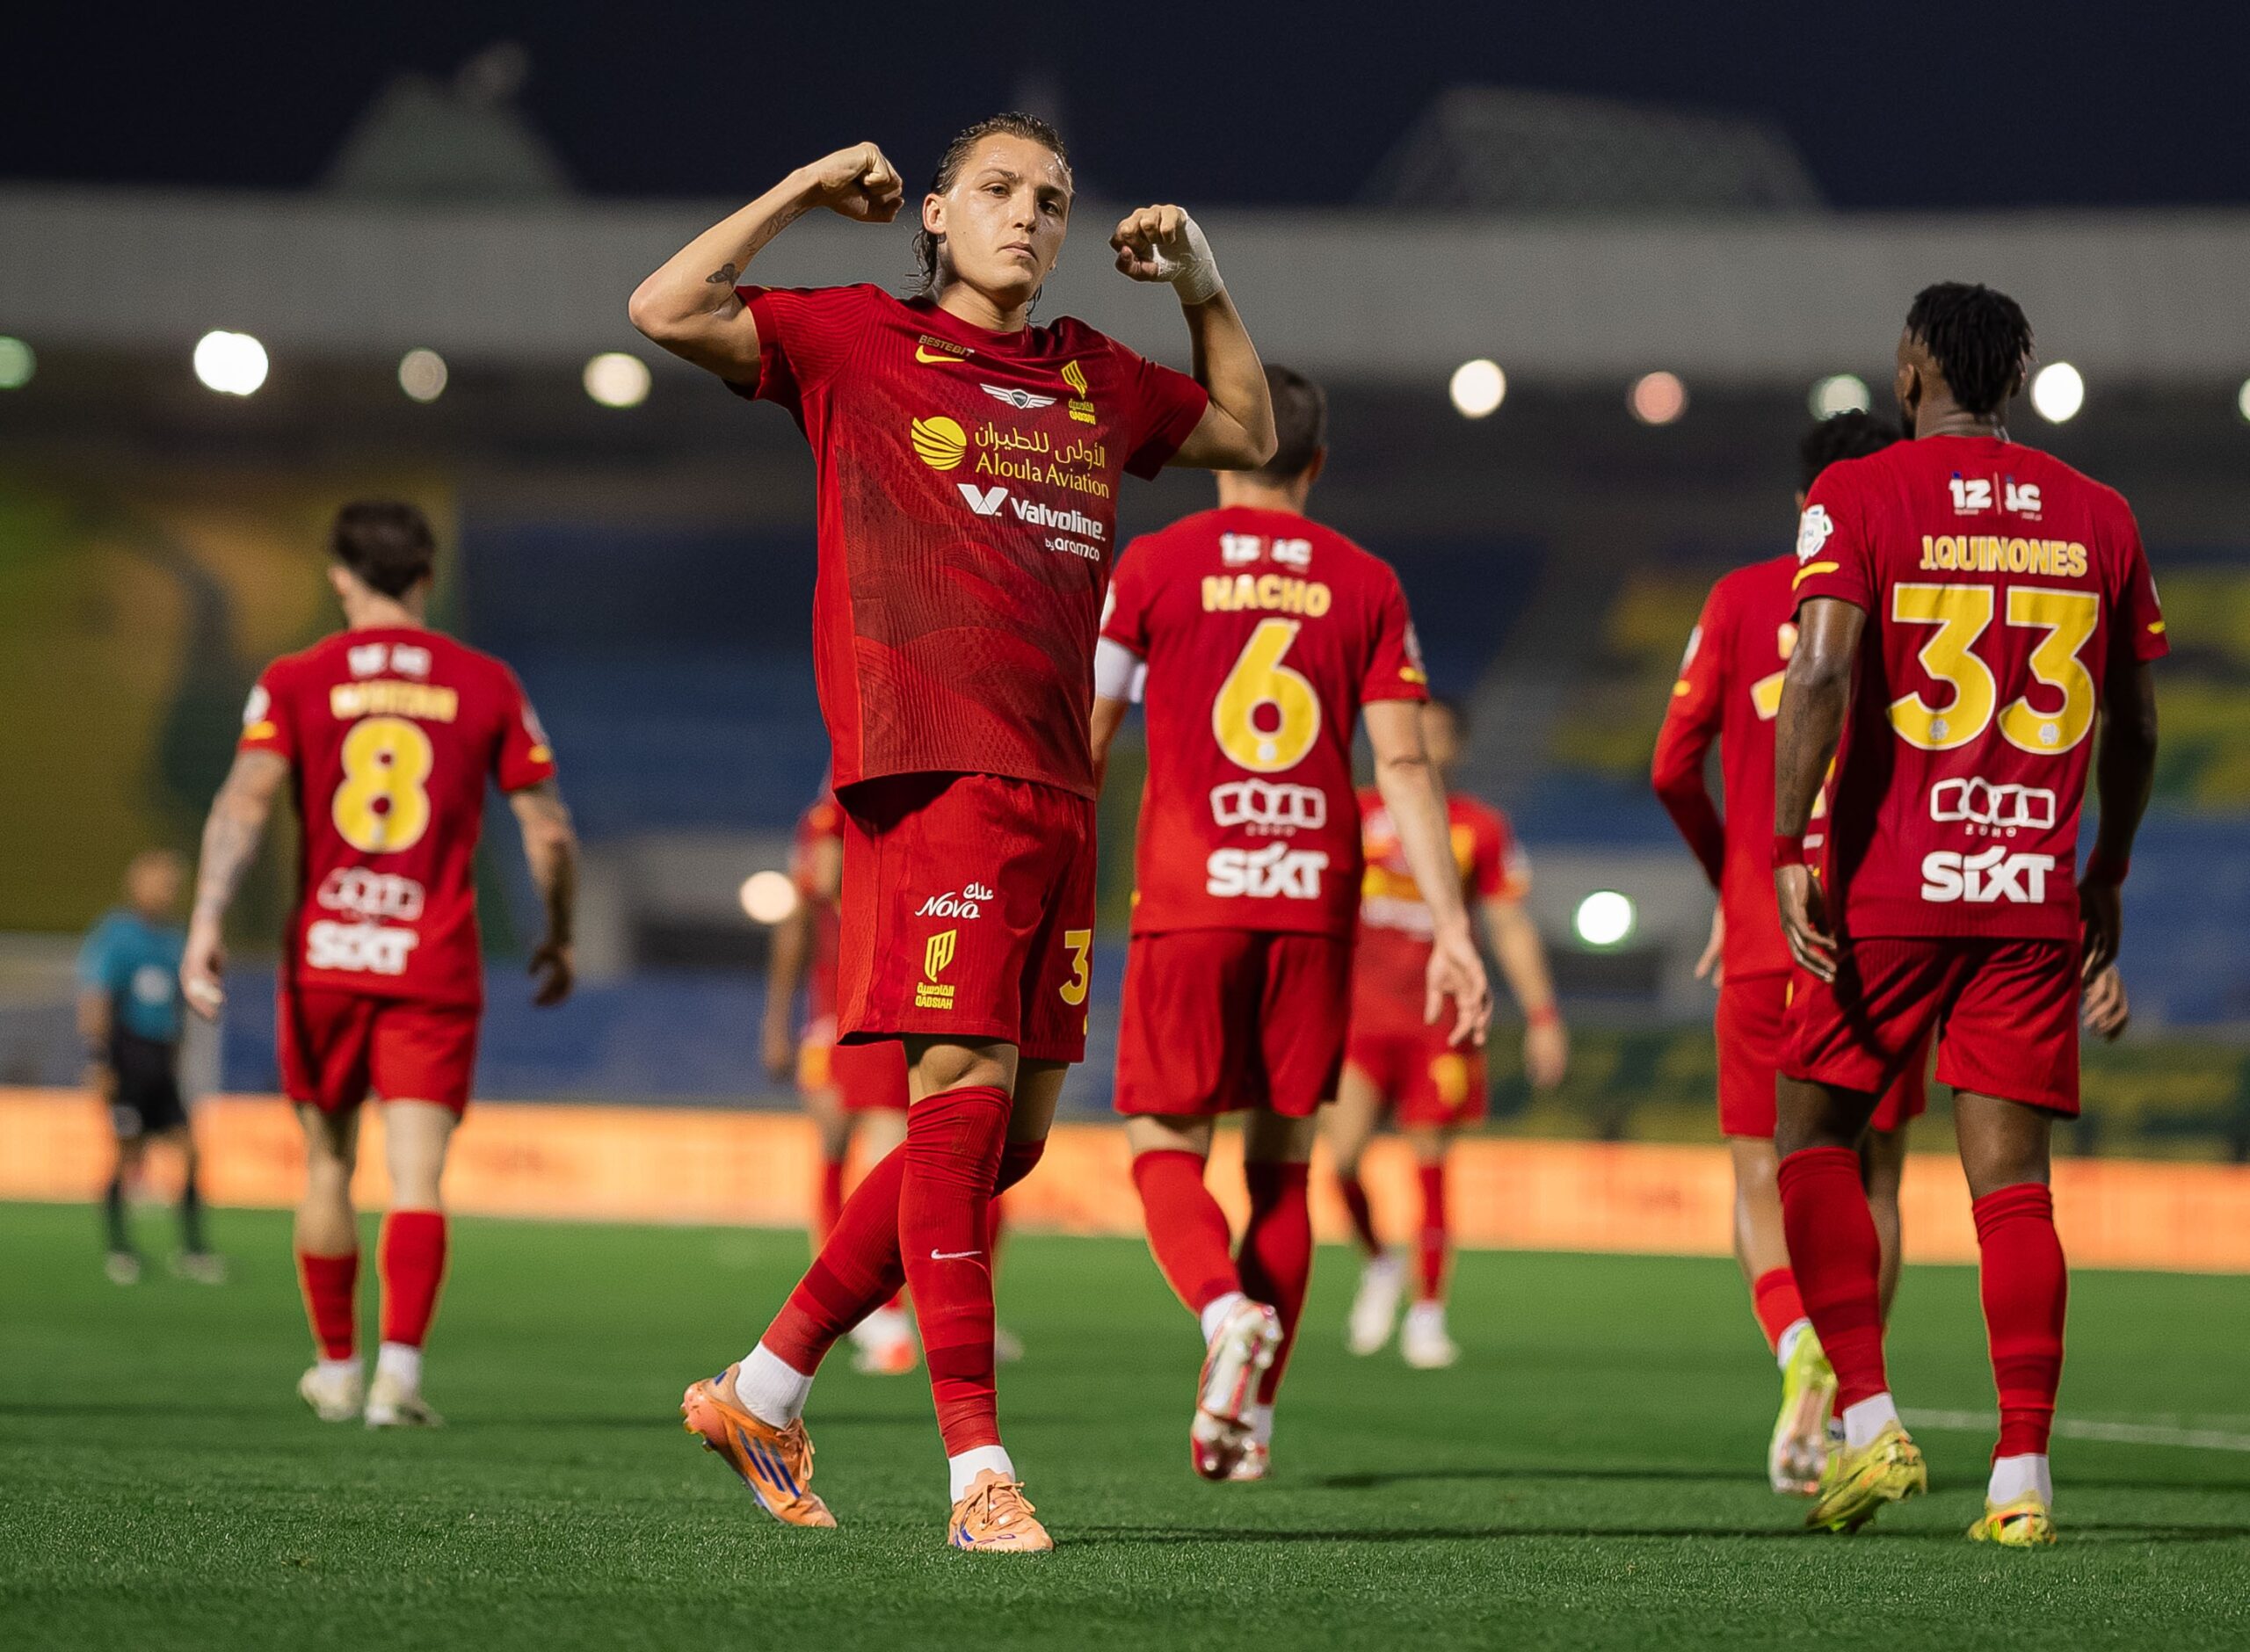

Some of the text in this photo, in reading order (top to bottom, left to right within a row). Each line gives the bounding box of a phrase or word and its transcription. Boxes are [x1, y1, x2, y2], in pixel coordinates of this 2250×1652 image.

[975, 421, 1106, 471] الأولى للطيران
[975, 451, 1110, 499] Aloula Aviation
[1011, 496, 1105, 541] Valvoline
[1044, 536, 1100, 562] by aramco
[1920, 534, 2088, 577] J.QUINONES
[1201, 573, 1332, 618] NACHO
[1886, 582, 2100, 755] 33
[1212, 617, 1321, 773] 6
[331, 716, 435, 854] 8
[1059, 929, 1092, 1006] 3
[914, 994, 954, 1011] QADSIAH
